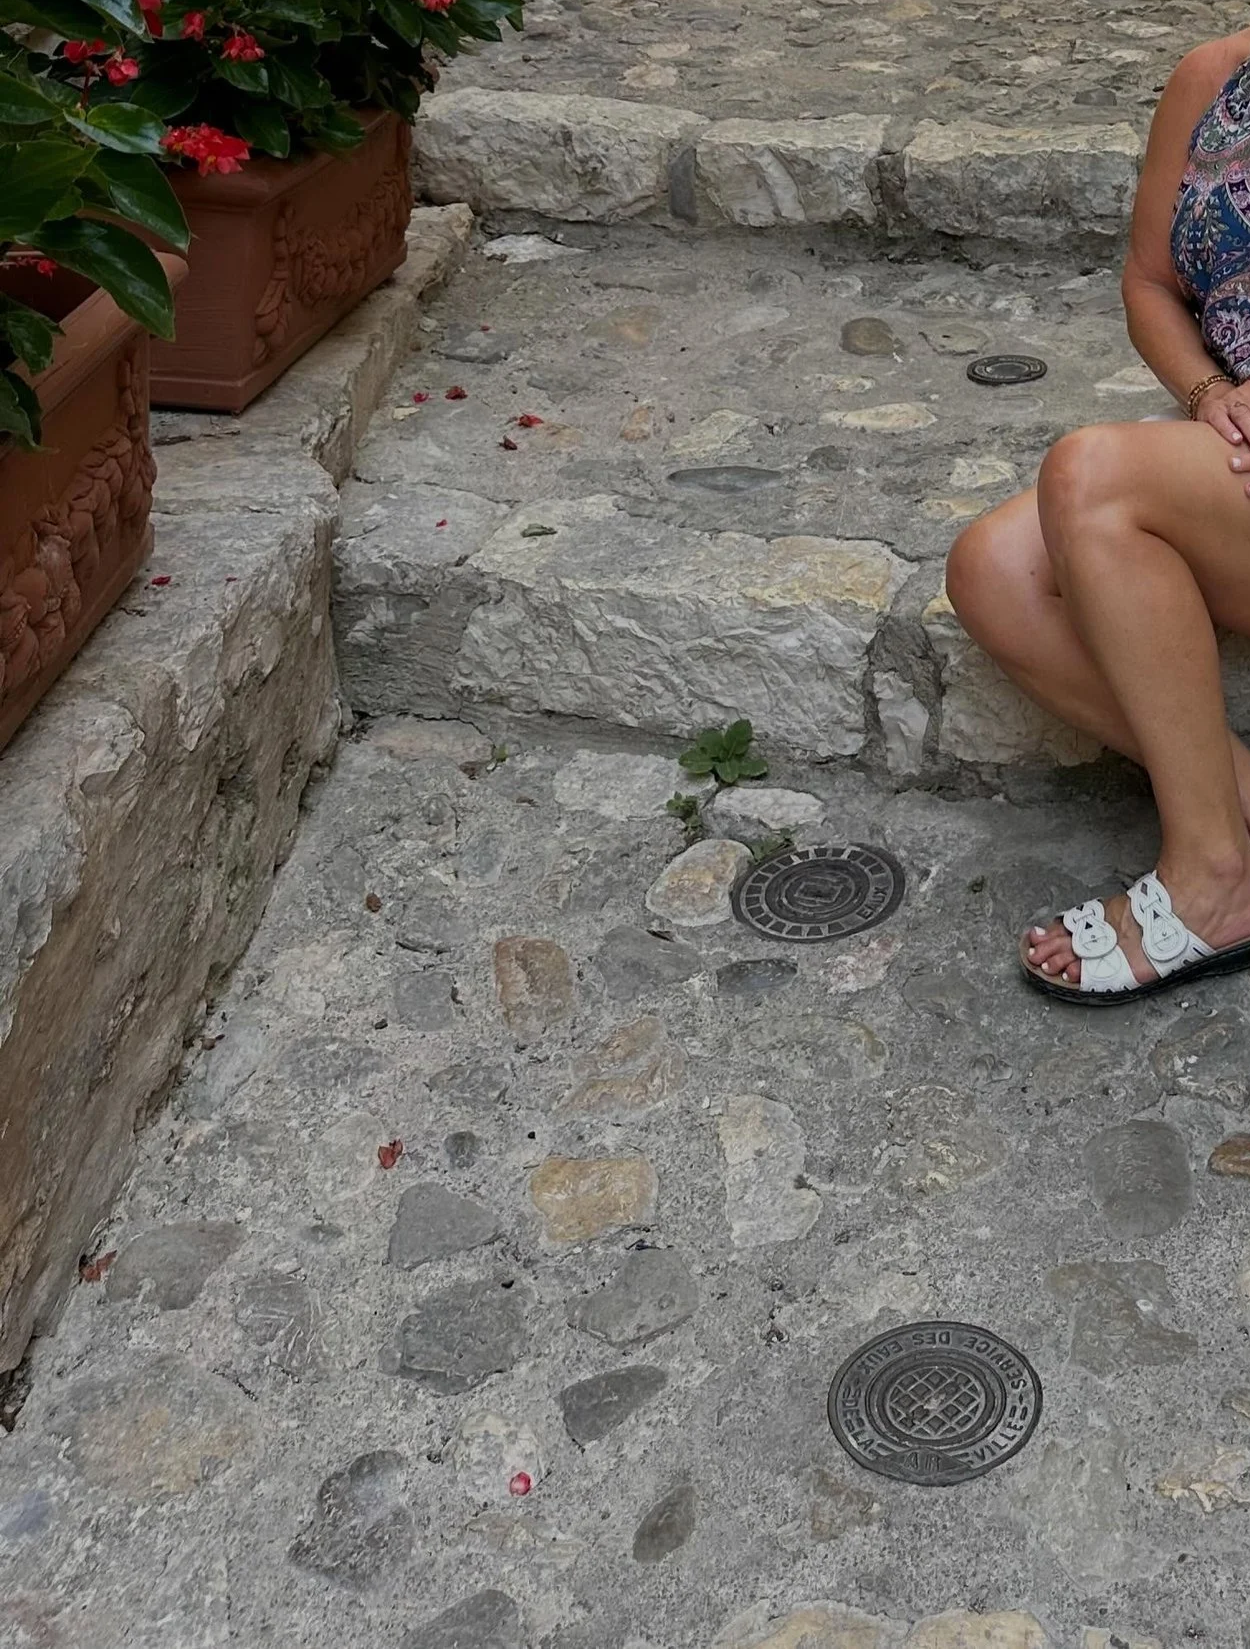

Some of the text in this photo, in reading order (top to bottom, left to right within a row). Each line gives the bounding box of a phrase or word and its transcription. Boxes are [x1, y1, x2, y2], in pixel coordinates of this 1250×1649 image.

[856, 886, 889, 919] EAUX
[858, 1331, 1027, 1390] SERVICE DES EAUX
[973, 1421, 1024, 1461] VILLE
